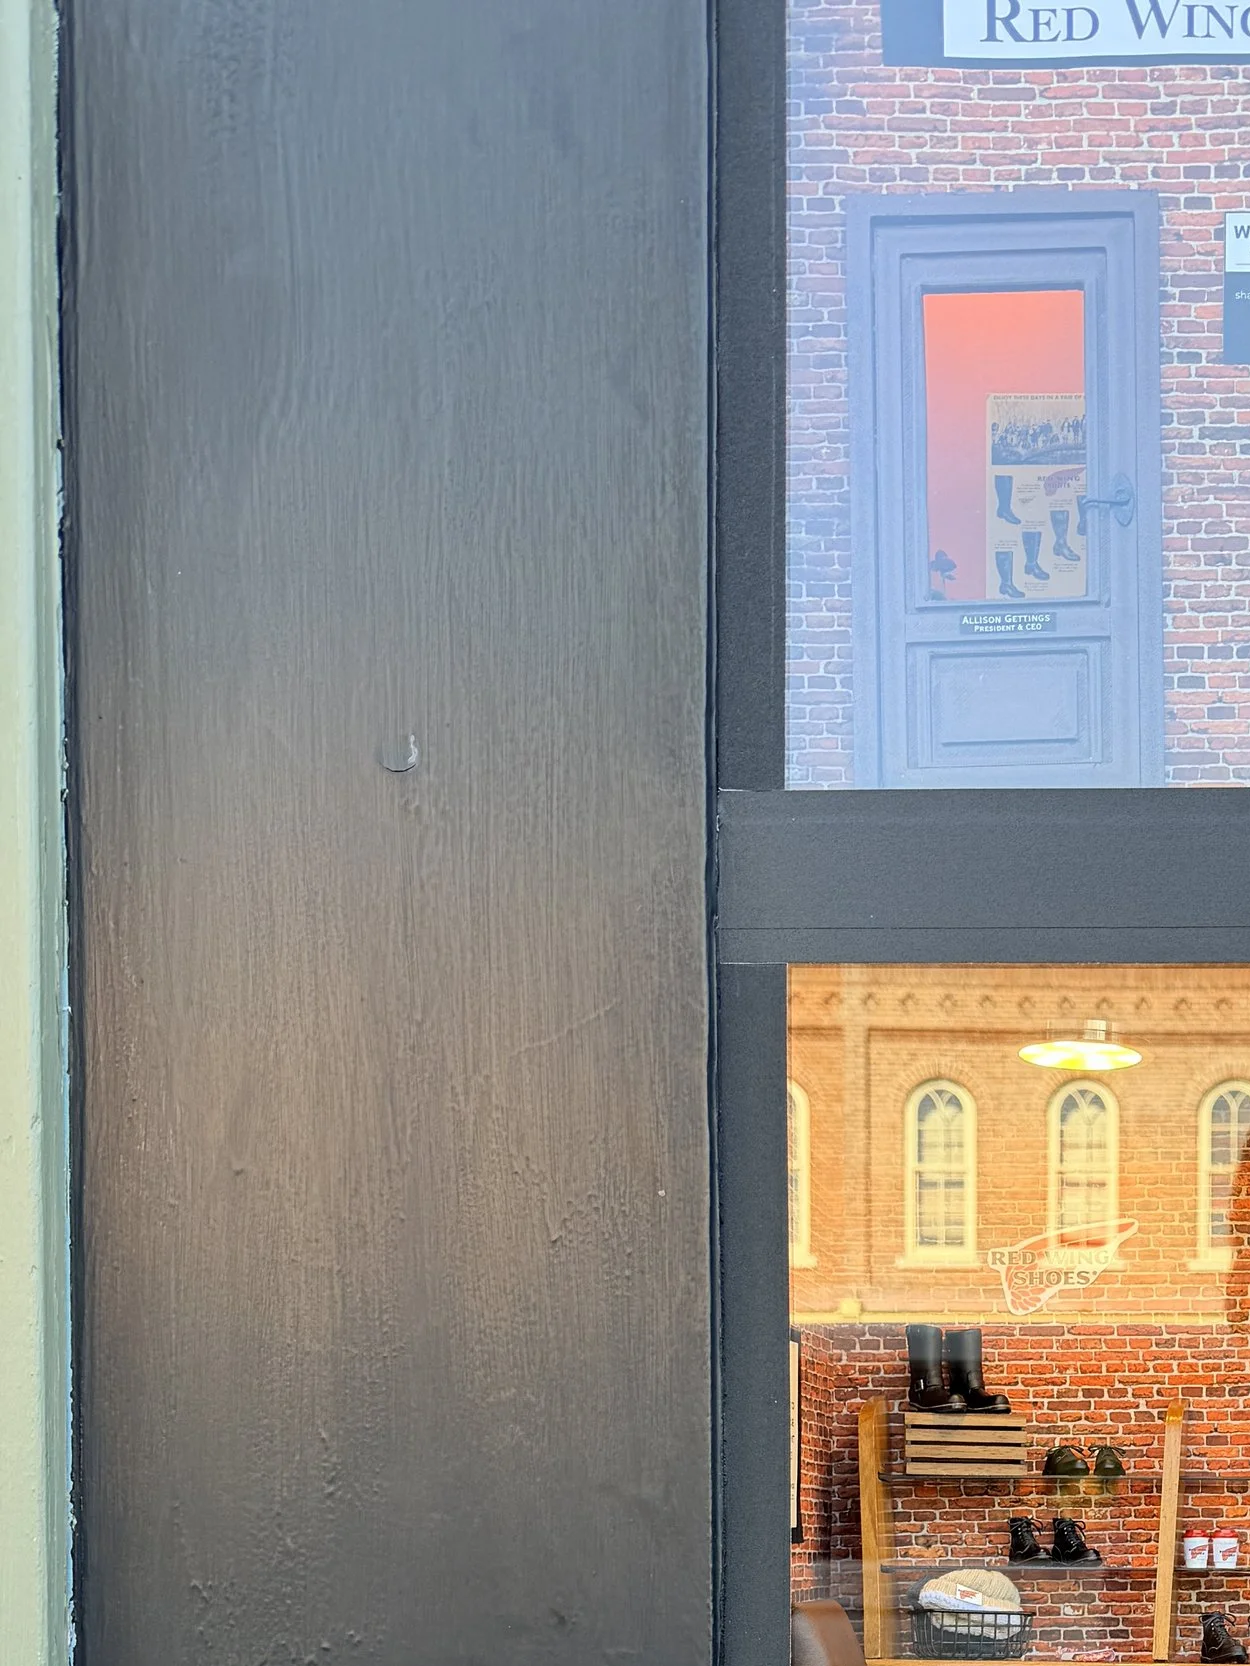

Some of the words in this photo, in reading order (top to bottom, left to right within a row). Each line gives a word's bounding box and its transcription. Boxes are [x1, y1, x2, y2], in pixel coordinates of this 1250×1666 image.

[979, 0, 1101, 43] RED
[962, 616, 1002, 625] ALLISON
[1004, 614, 1051, 623] GETTINGS
[974, 625, 1015, 633] PRESIDENT
[1026, 623, 1042, 631] CEO
[991, 1251, 1037, 1266] RED
[1045, 1250, 1109, 1265] WING
